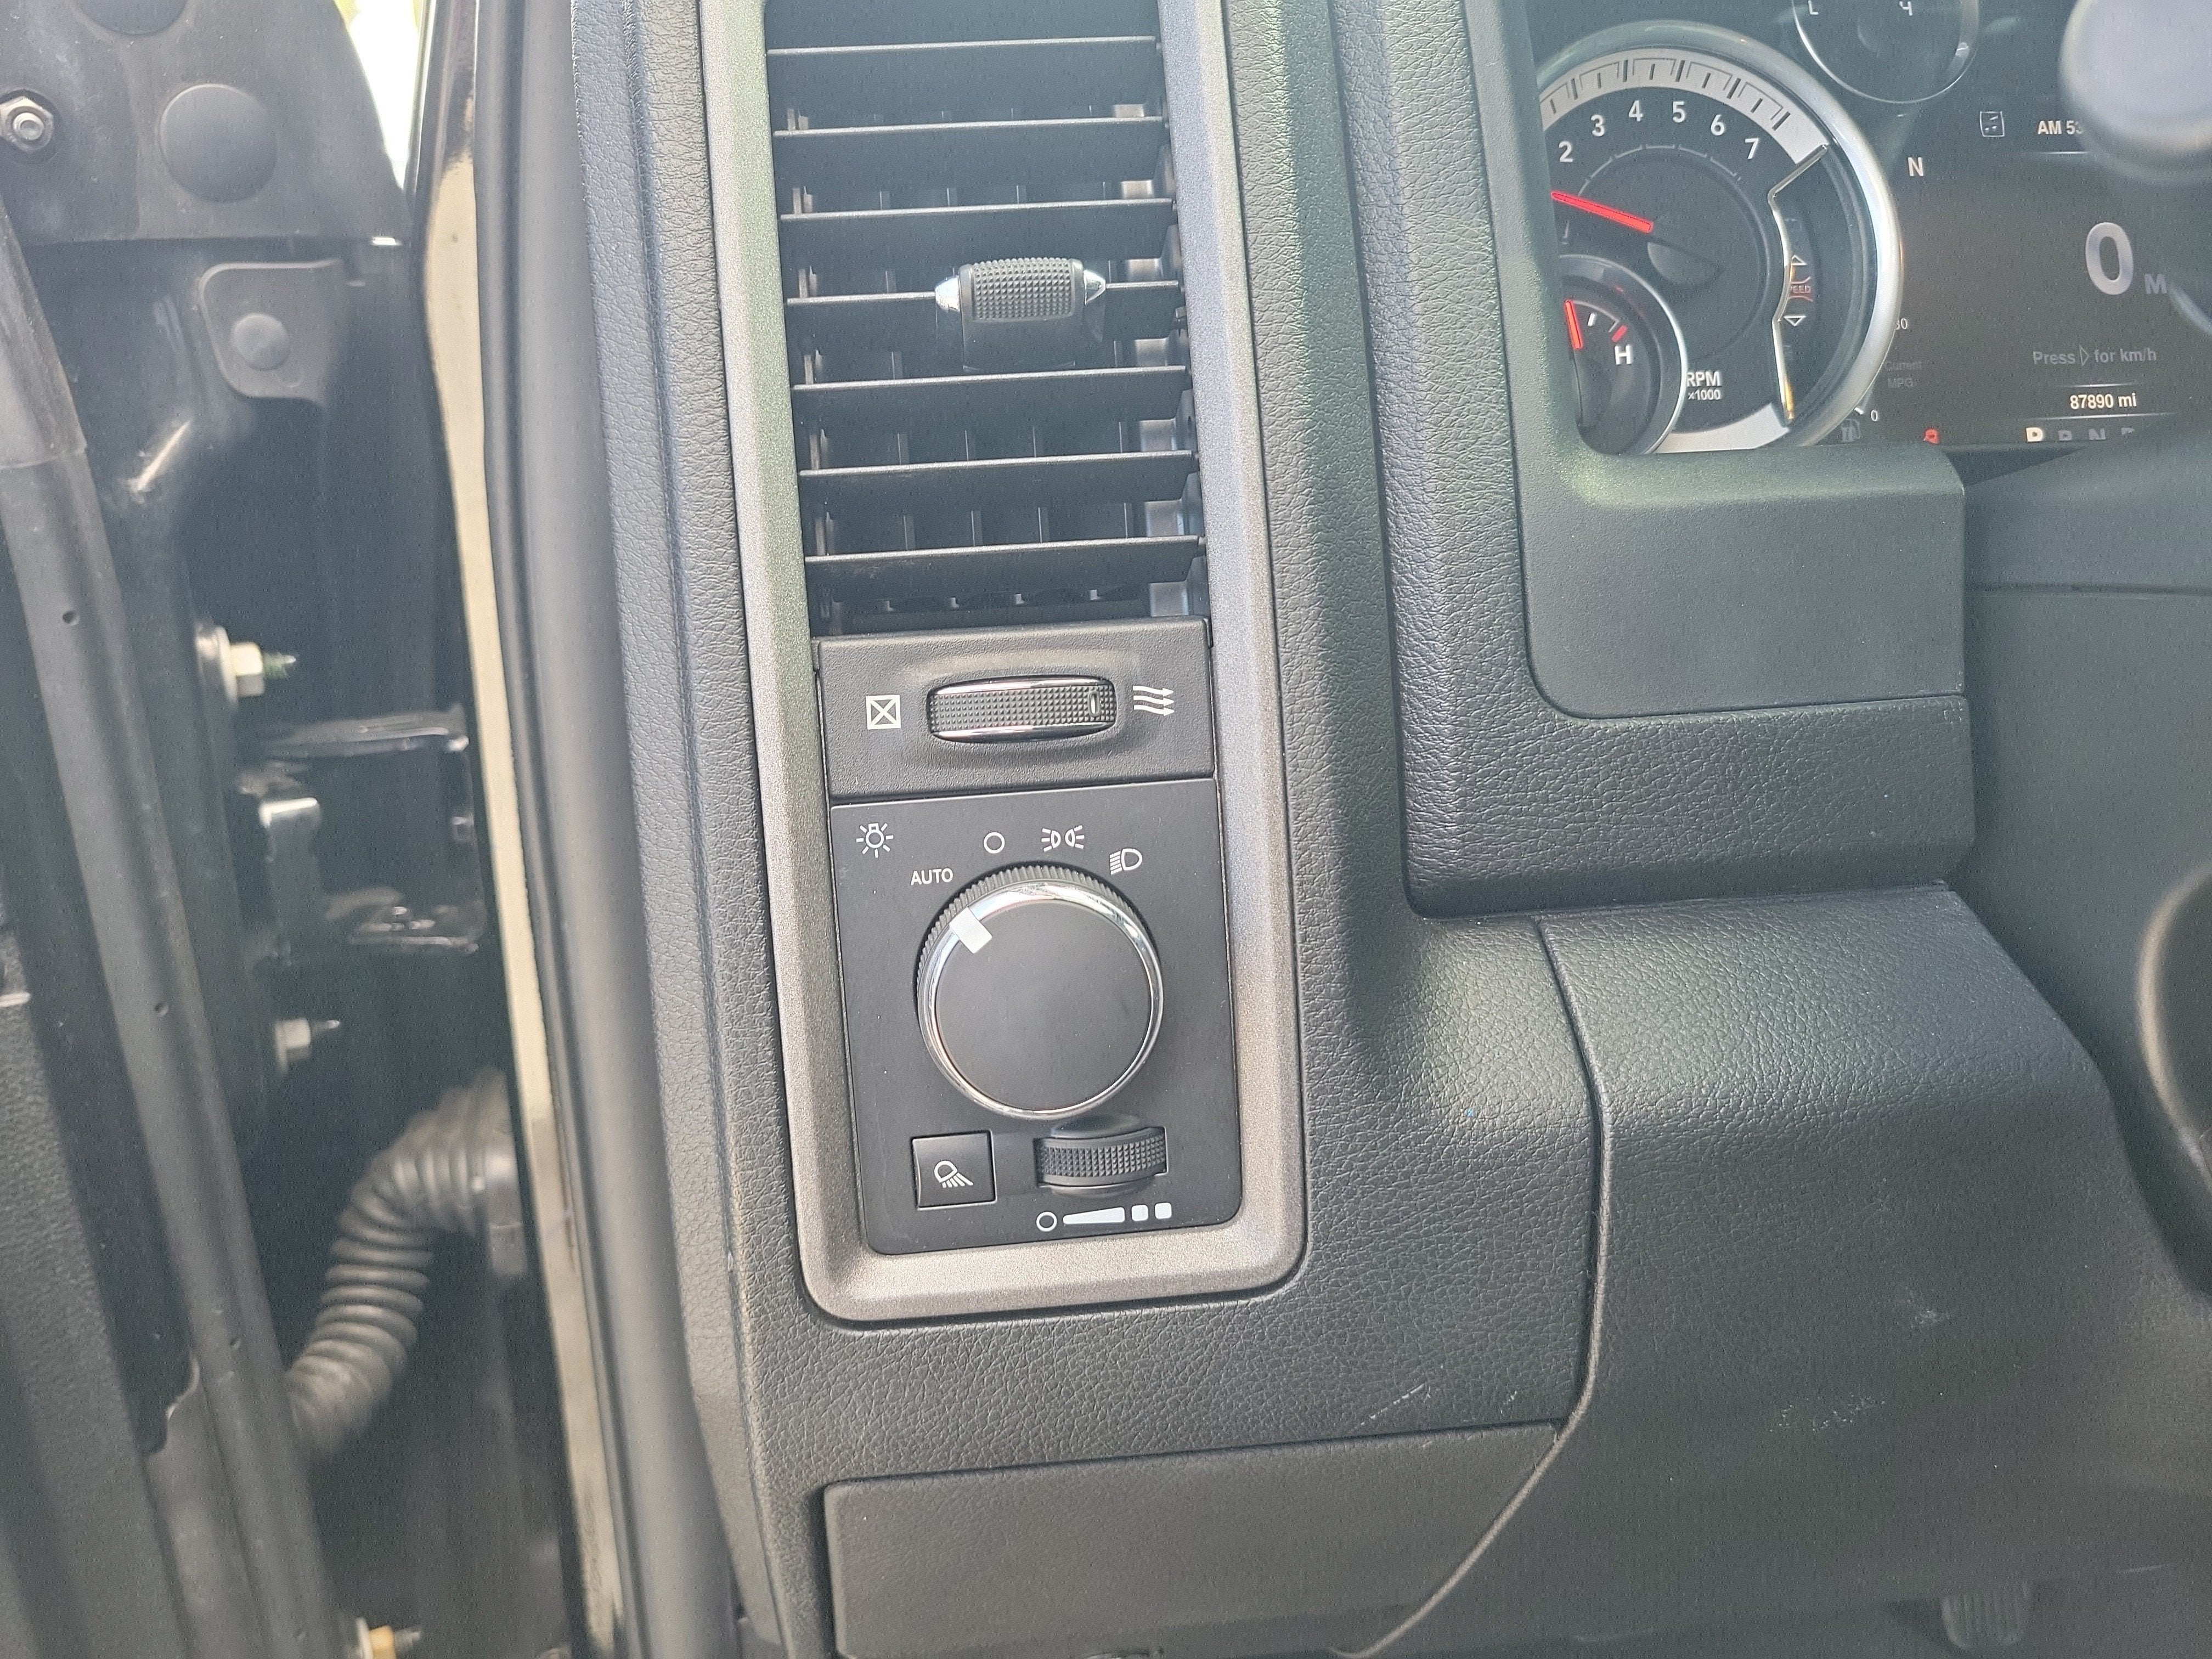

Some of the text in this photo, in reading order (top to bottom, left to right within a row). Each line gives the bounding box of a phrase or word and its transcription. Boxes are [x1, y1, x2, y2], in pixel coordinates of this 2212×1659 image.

[1559, 100, 1759, 163] 2 3 4 5 6 7
[2037, 120, 2063, 135] AM
[1908, 157, 1924, 177] N
[2085, 222, 2134, 296] 0
[1615, 345, 1633, 365] H
[2033, 347, 2157, 365] Press for km/h
[1686, 371, 1721, 387] RPM
[2069, 392, 2137, 410] 87890 mi
[1870, 409, 1879, 422] 0
[911, 868, 953, 886] AUTO
